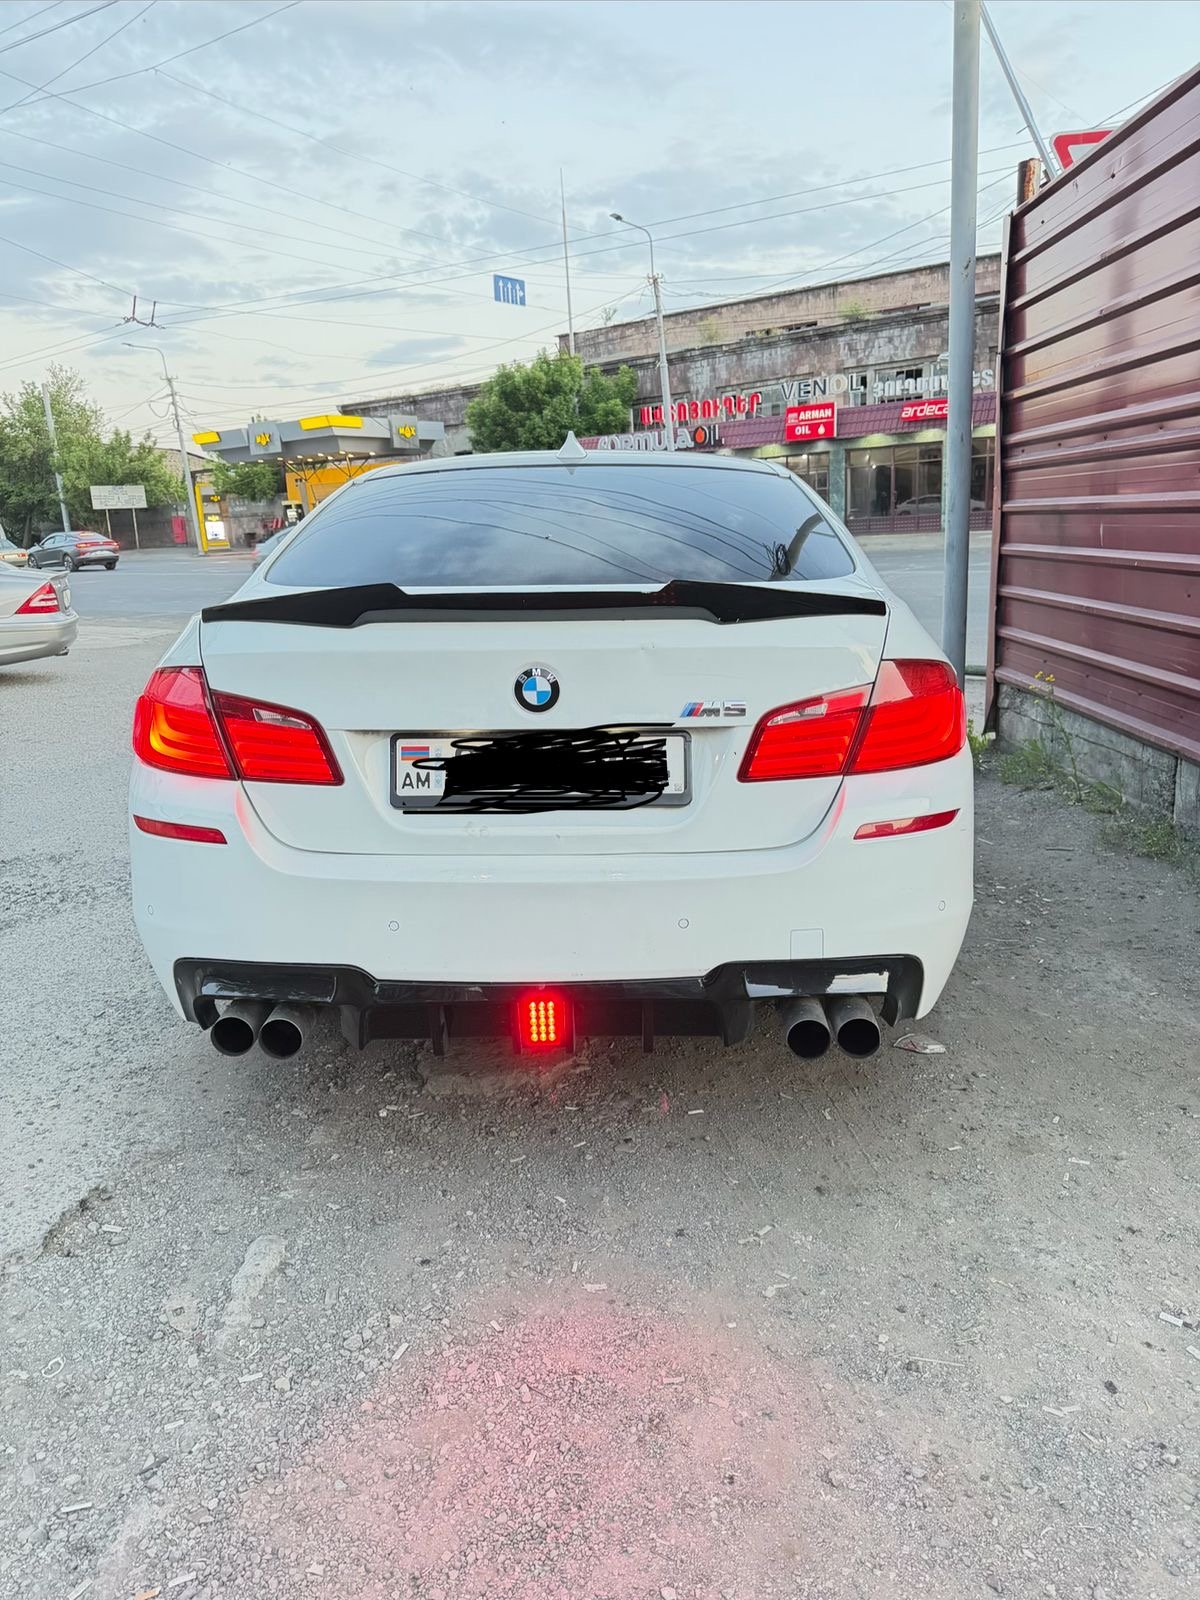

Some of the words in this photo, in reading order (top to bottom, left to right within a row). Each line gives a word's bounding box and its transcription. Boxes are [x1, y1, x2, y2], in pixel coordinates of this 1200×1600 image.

[781, 373, 864, 400] VENOL
[799, 408, 832, 420] ARMAN
[795, 425, 811, 435] OIL
[518, 668, 556, 684] BMW
[697, 700, 747, 717] M5
[401, 771, 431, 789] AM
